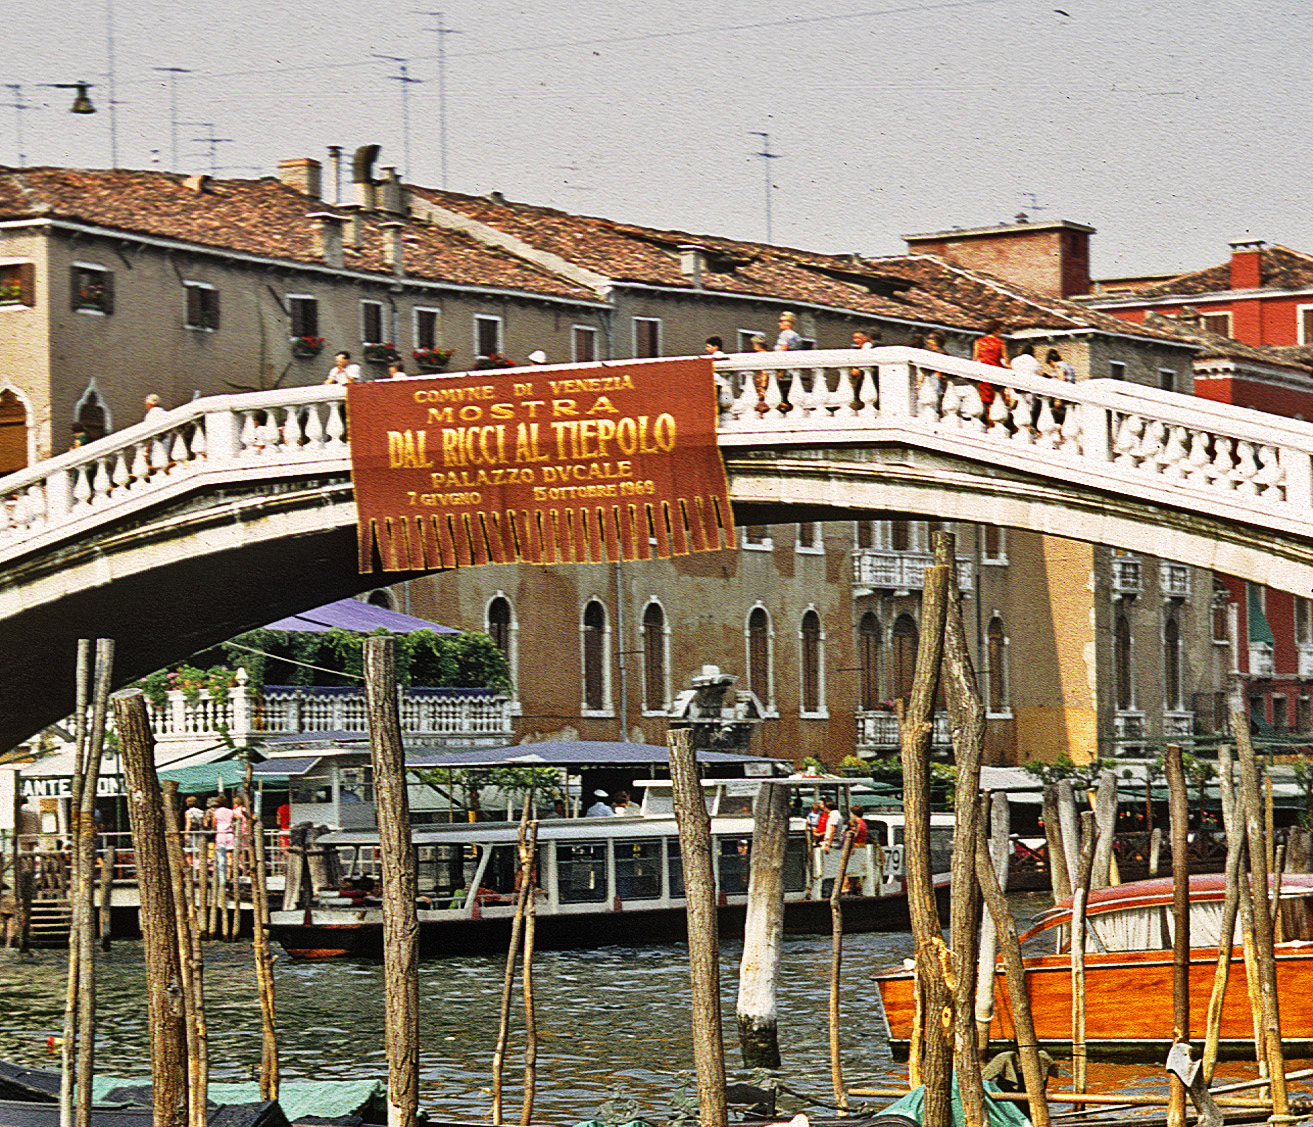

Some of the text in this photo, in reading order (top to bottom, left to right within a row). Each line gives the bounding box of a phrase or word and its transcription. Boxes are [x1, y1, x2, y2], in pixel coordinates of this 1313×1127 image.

[513, 382, 533, 397] DI
[548, 375, 636, 395] VENEZIA
[426, 396, 620, 424] MOSTRA
[387, 413, 676, 468] DAL RICCI AL TIEPOLO
[430, 460, 633, 488] PALAZZO DVCALE
[407, 491, 417, 505] 7
[548, 484, 618, 500] OTTOBRE
